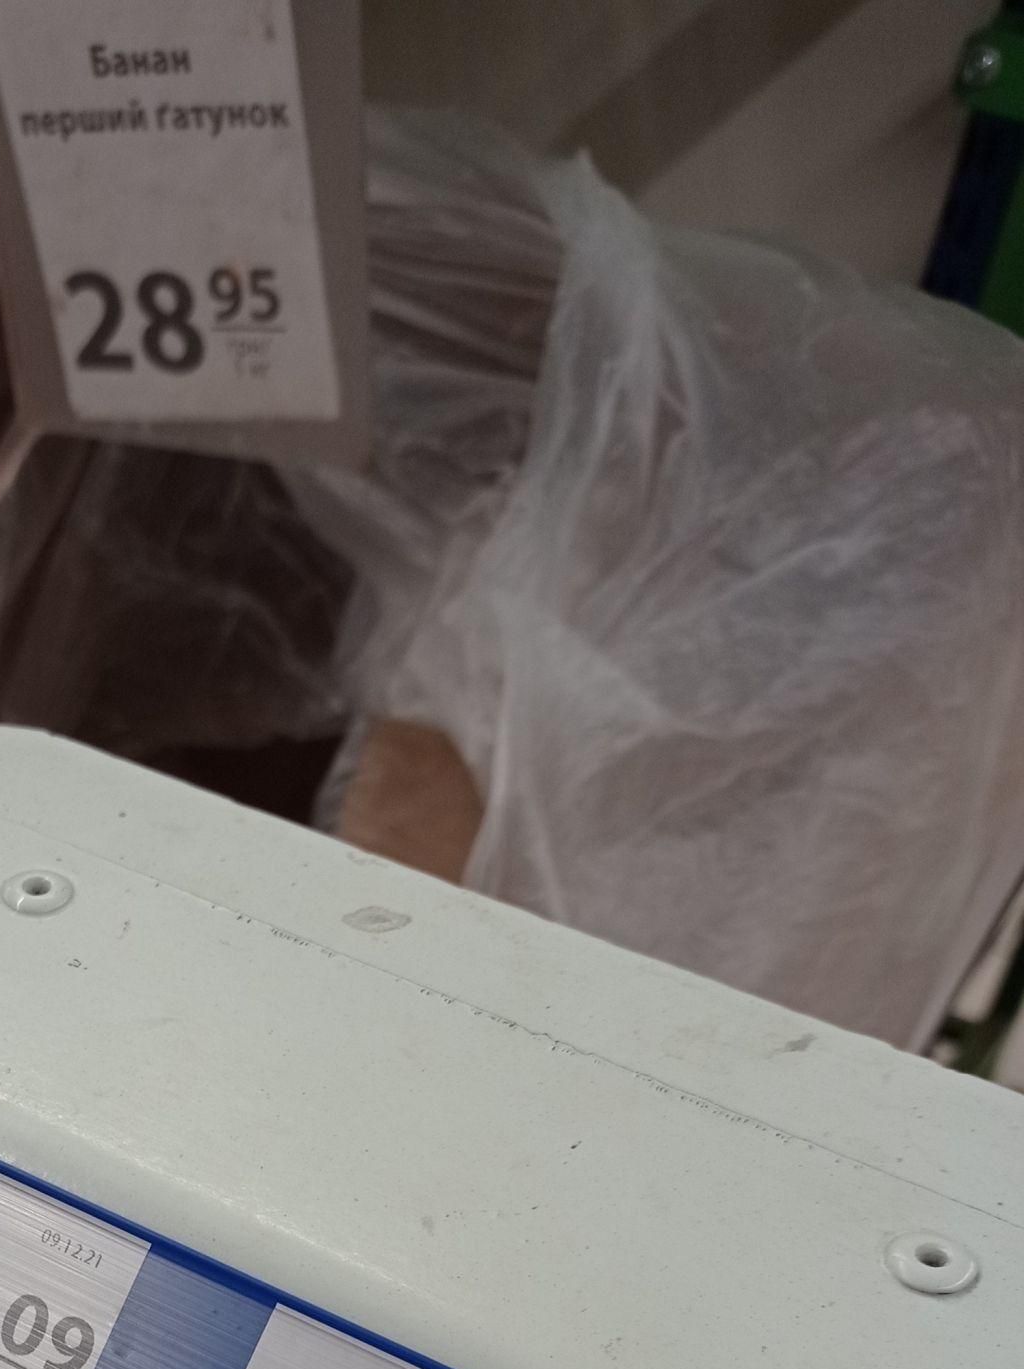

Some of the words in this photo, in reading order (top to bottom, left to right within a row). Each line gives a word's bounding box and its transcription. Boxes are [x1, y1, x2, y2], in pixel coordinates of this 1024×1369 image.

[89, 44, 192, 78] Банан
[21, 100, 148, 141] перший
[65, 270, 205, 375] 28
[208, 267, 280, 323] 95
[41, 1229, 103, 1269] 09.12.21
